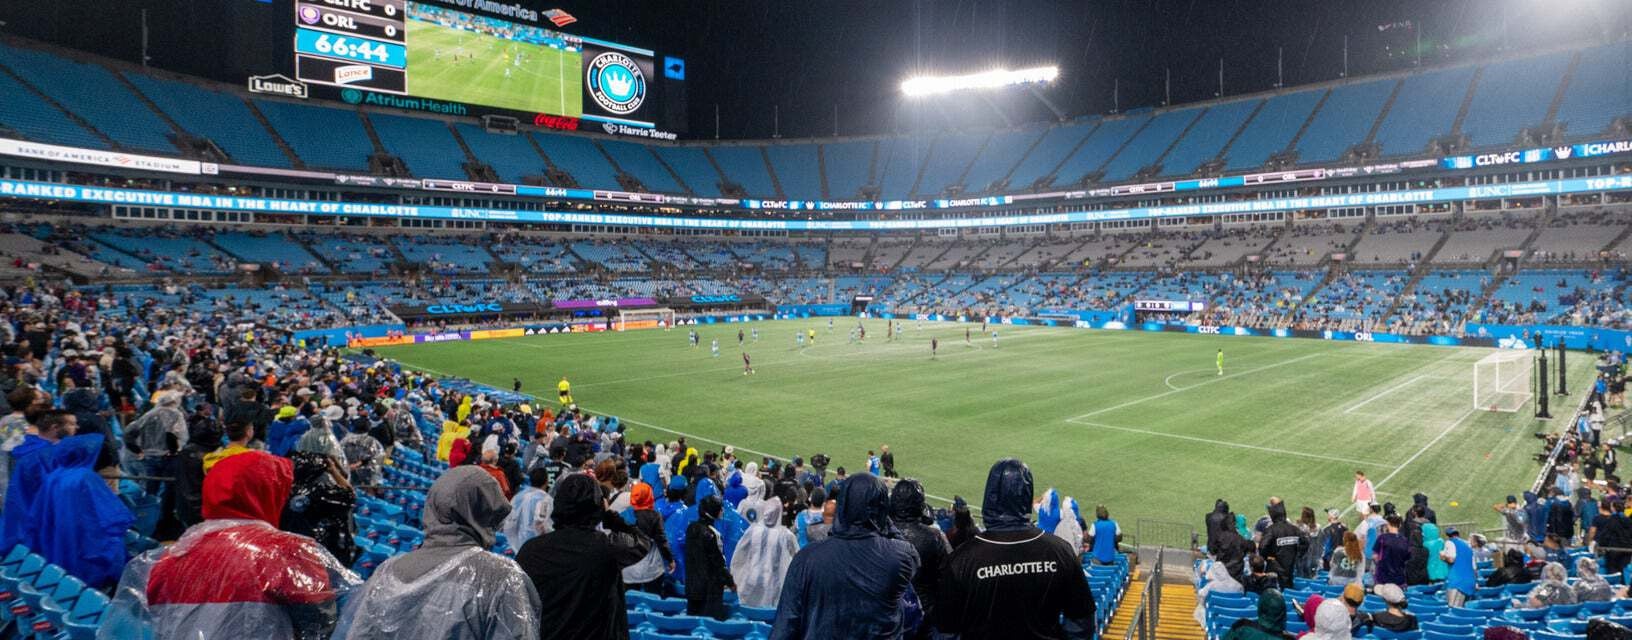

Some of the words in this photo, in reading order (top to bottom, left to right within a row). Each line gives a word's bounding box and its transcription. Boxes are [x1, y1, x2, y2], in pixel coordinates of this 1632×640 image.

[323, 0, 371, 11] LTFC
[384, 4, 396, 16] 0
[474, 0, 538, 21] America
[322, 13, 358, 30] ORL
[384, 25, 396, 37] 0
[315, 34, 389, 62] 66:44
[337, 68, 370, 80] Lance
[596, 54, 641, 77] CHARLOTTE
[254, 79, 303, 96] LOWE'S
[365, 93, 420, 109] Atrium
[421, 101, 467, 115] Health
[596, 91, 627, 111] FOOTBALL
[627, 97, 641, 109] CLUB
[619, 125, 649, 137] Harris
[649, 129, 677, 141] Teeter
[1589, 140, 1632, 155] CHARL
[18, 146, 45, 155] BANK
[47, 149, 60, 158] OF
[63, 152, 110, 163] AMERICA
[135, 160, 181, 170] STADIUM
[1311, 196, 1346, 207] HEART
[1348, 194, 1362, 204] OF
[1367, 191, 1434, 204] CHARLOTTE
[1478, 185, 1507, 197] UNC
[82, 188, 174, 204] EXECUTIVE
[178, 194, 213, 207] MBA
[216, 197, 233, 208] IN
[237, 198, 266, 210] THE
[270, 200, 317, 213] HEART
[321, 202, 339, 213] OF
[343, 203, 419, 216] CHARLOTTE
[458, 208, 484, 218] UNC
[543, 213, 603, 223] TOP-RANKED
[605, 215, 653, 225] EXECUTIVE
[740, 219, 786, 228] CHARLOTTE
[1355, 331, 1375, 341] ORL
[976, 561, 1044, 580] CHARLOTTE
[1044, 560, 1057, 573] FC
